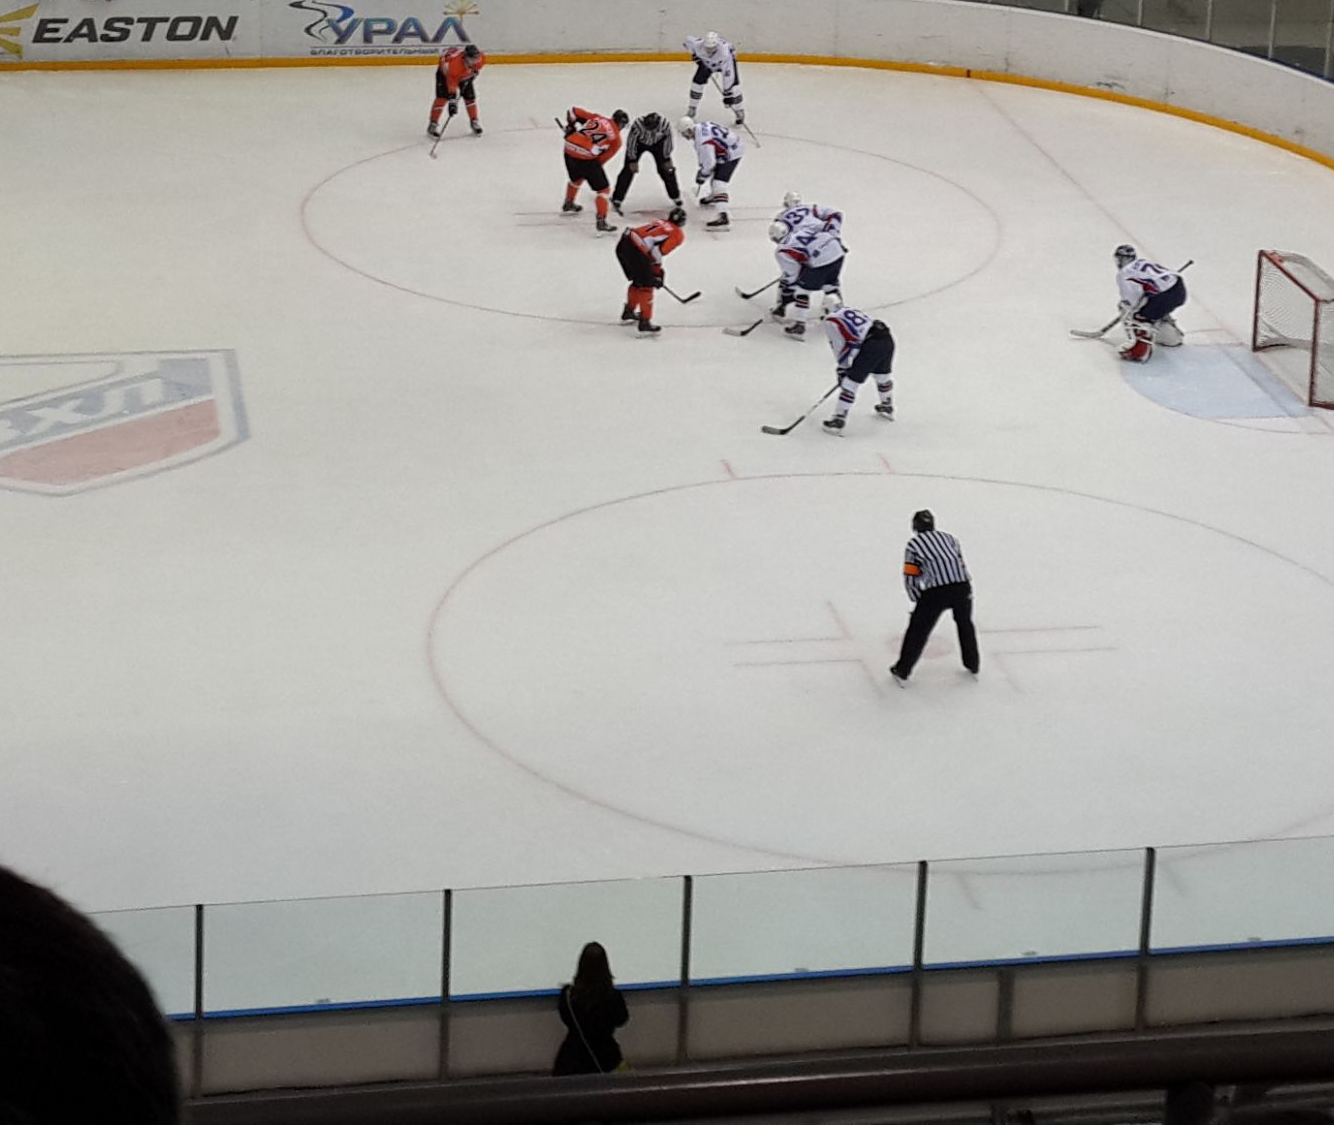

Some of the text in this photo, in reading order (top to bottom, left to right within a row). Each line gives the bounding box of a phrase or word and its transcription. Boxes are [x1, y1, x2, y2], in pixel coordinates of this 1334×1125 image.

[32, 16, 239, 44] EASTON
[327, 17, 471, 45] УРАЛ
[577, 118, 608, 145] 24
